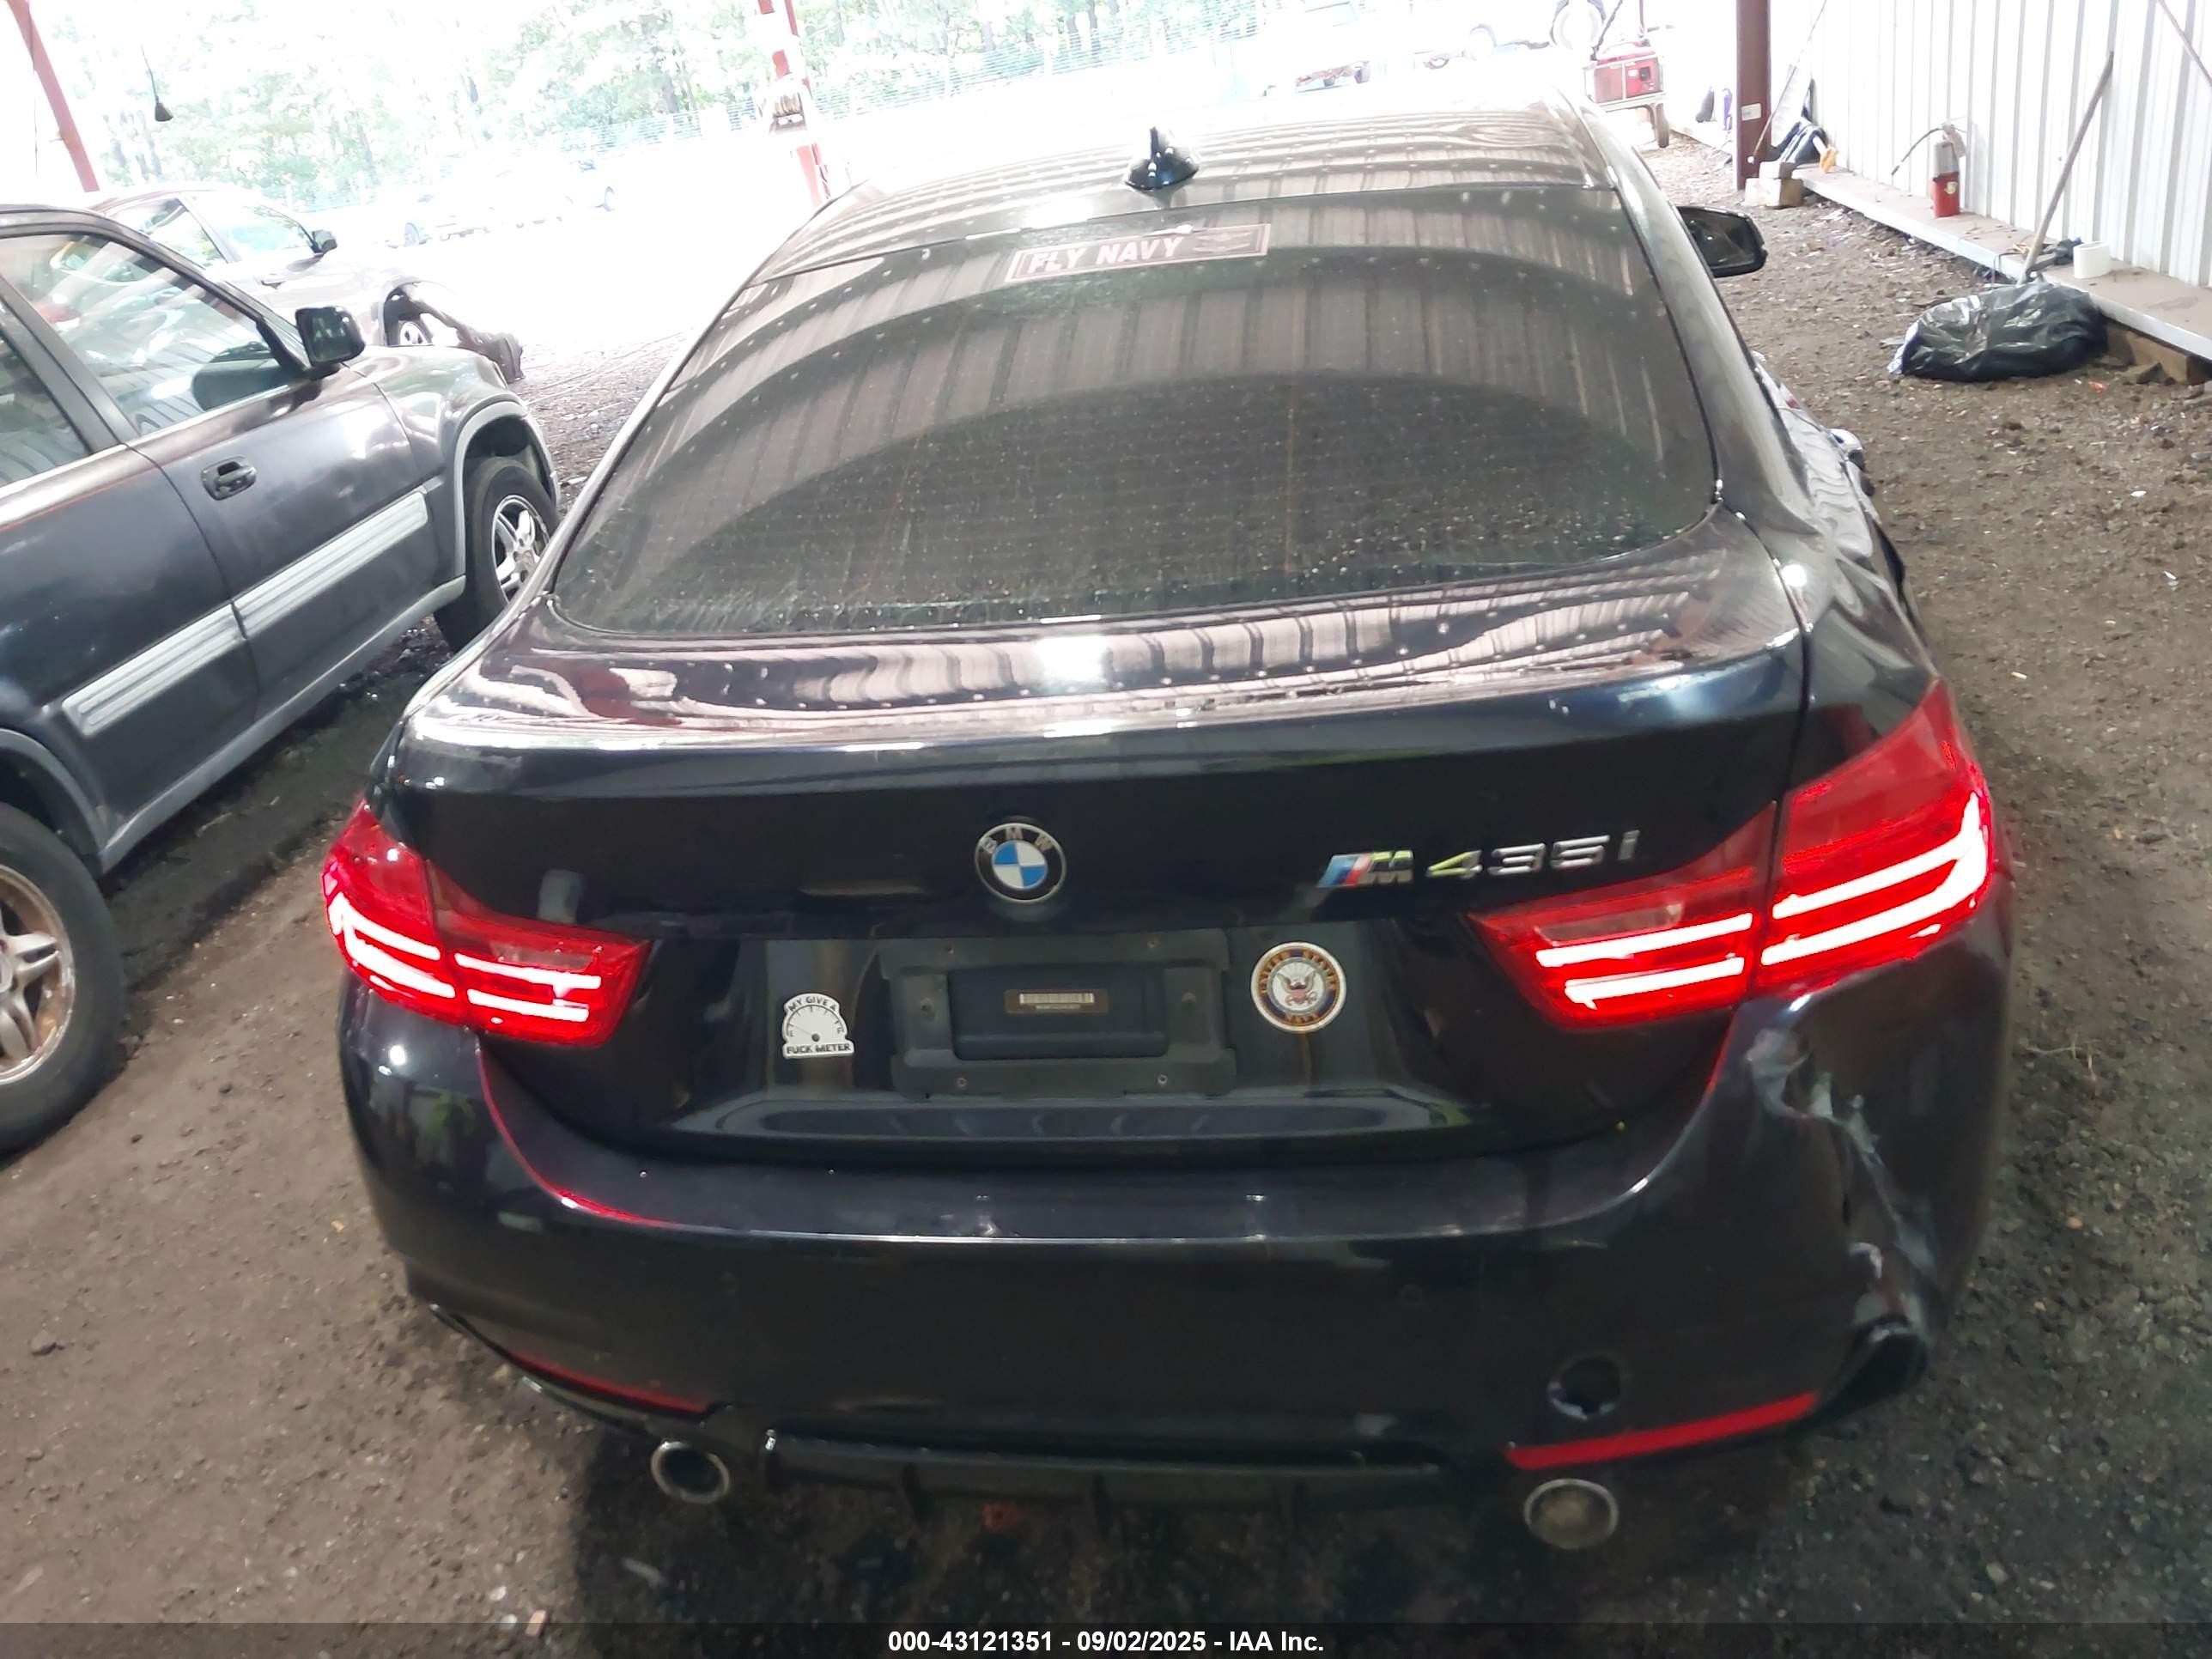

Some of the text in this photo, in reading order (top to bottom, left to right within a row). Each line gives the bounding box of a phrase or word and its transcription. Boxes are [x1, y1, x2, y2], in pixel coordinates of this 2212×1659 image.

[1027, 237, 1182, 273] FLY NAVY
[980, 827, 1054, 854] BMW
[787, 998, 802, 1012] MY
[805, 996, 829, 1006] GIVE
[787, 1043, 851, 1054] FUCK METER
